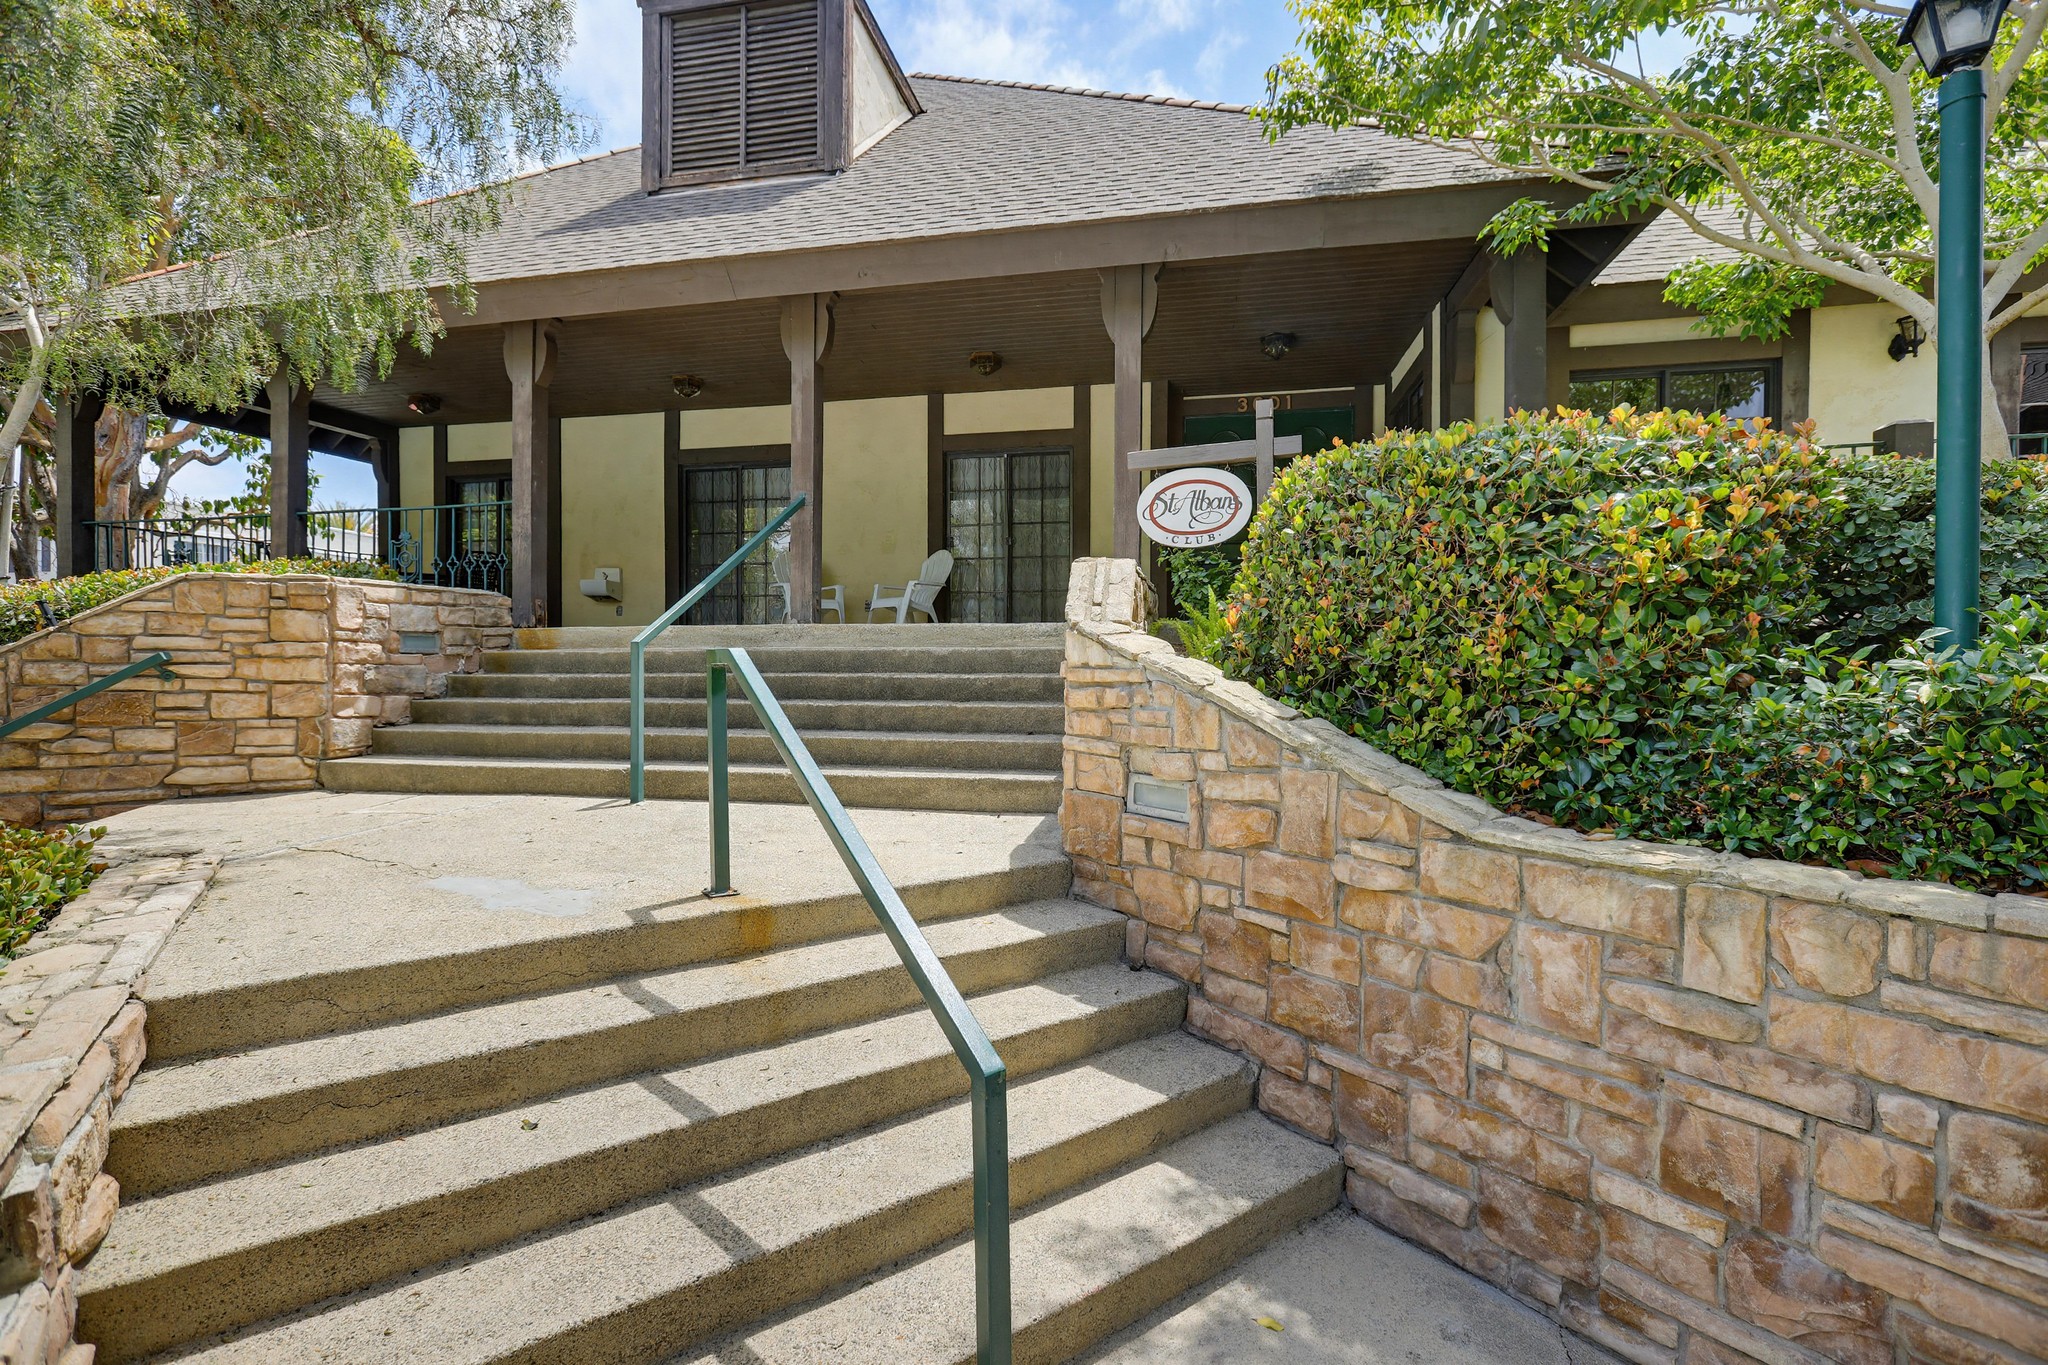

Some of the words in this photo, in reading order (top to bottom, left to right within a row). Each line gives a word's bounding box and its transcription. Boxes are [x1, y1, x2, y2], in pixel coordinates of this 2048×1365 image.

[1143, 492, 1178, 520] St
[1174, 490, 1243, 529] Albans
[1171, 533, 1216, 545] CLUB
